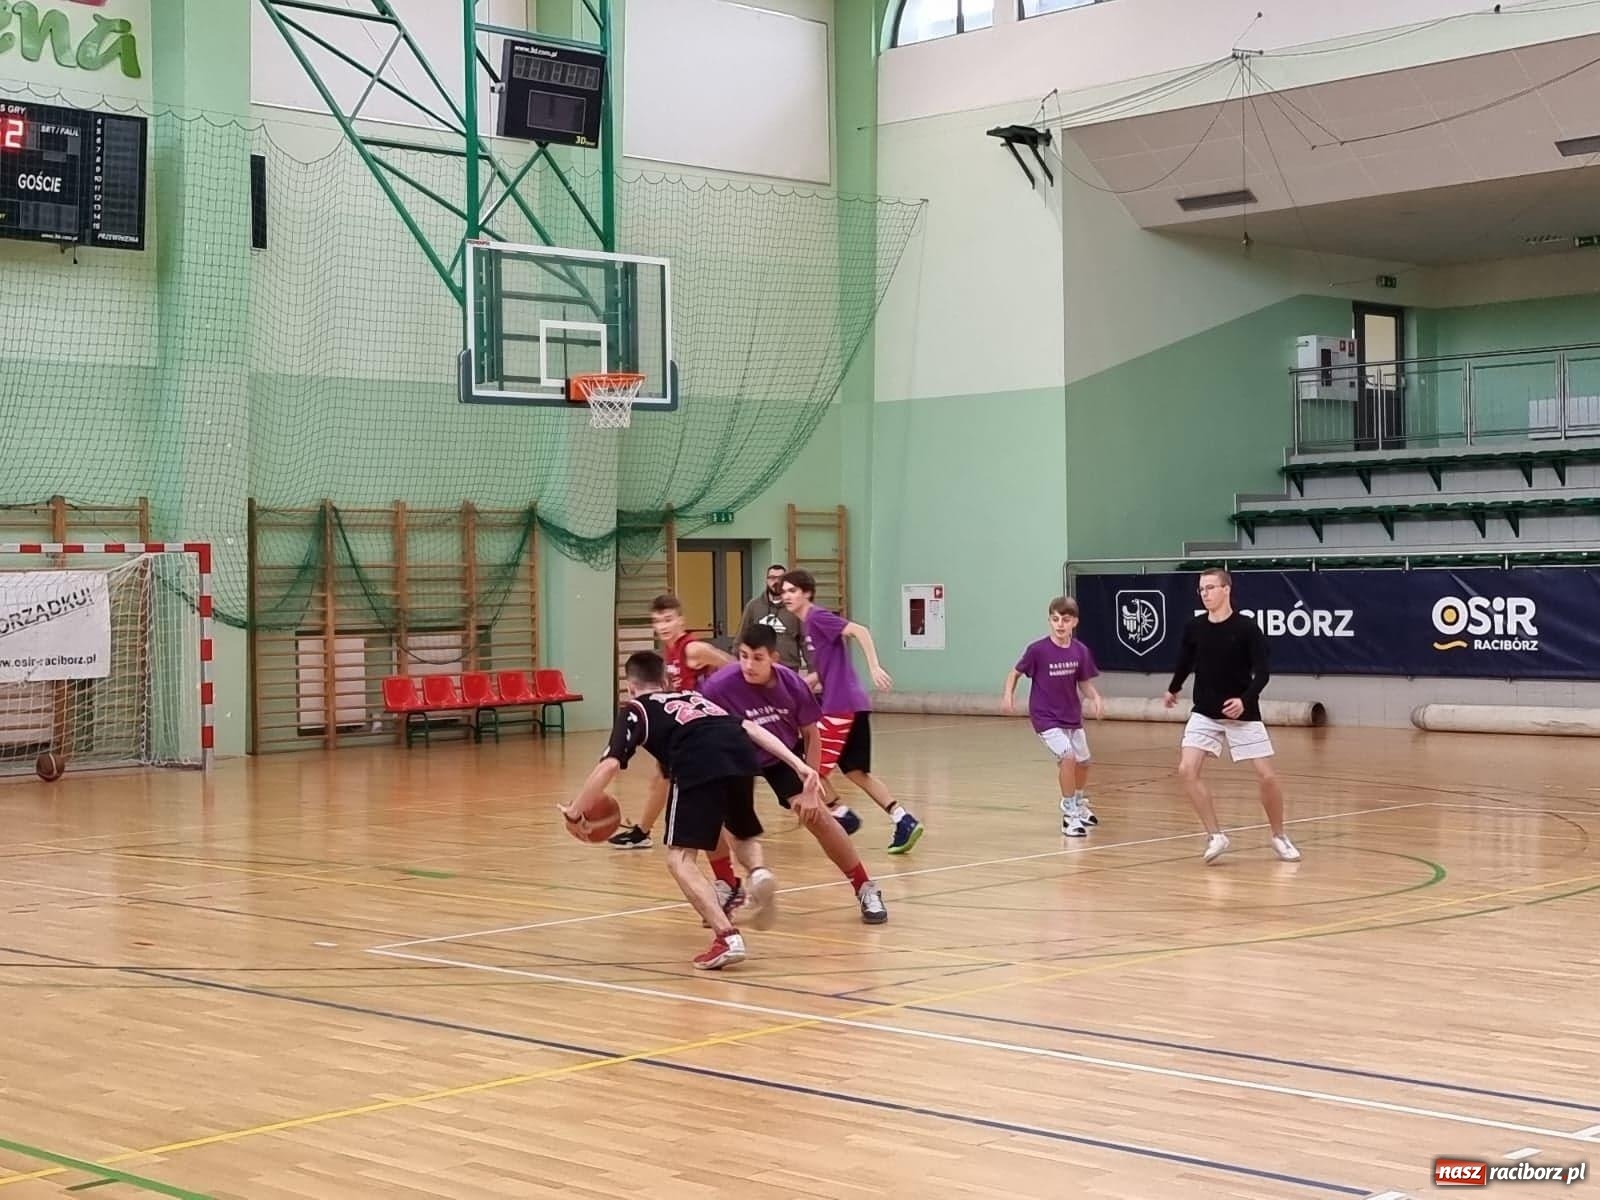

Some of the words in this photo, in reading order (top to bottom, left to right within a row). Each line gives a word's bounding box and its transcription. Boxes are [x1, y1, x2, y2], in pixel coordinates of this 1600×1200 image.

[8, 105, 26, 114] GRY
[18, 171, 62, 192] GOŚCIE
[1194, 601, 1354, 637] IBÓRZ
[1432, 596, 1538, 635] OSiR
[1474, 638, 1538, 651] RACIBÓRZ
